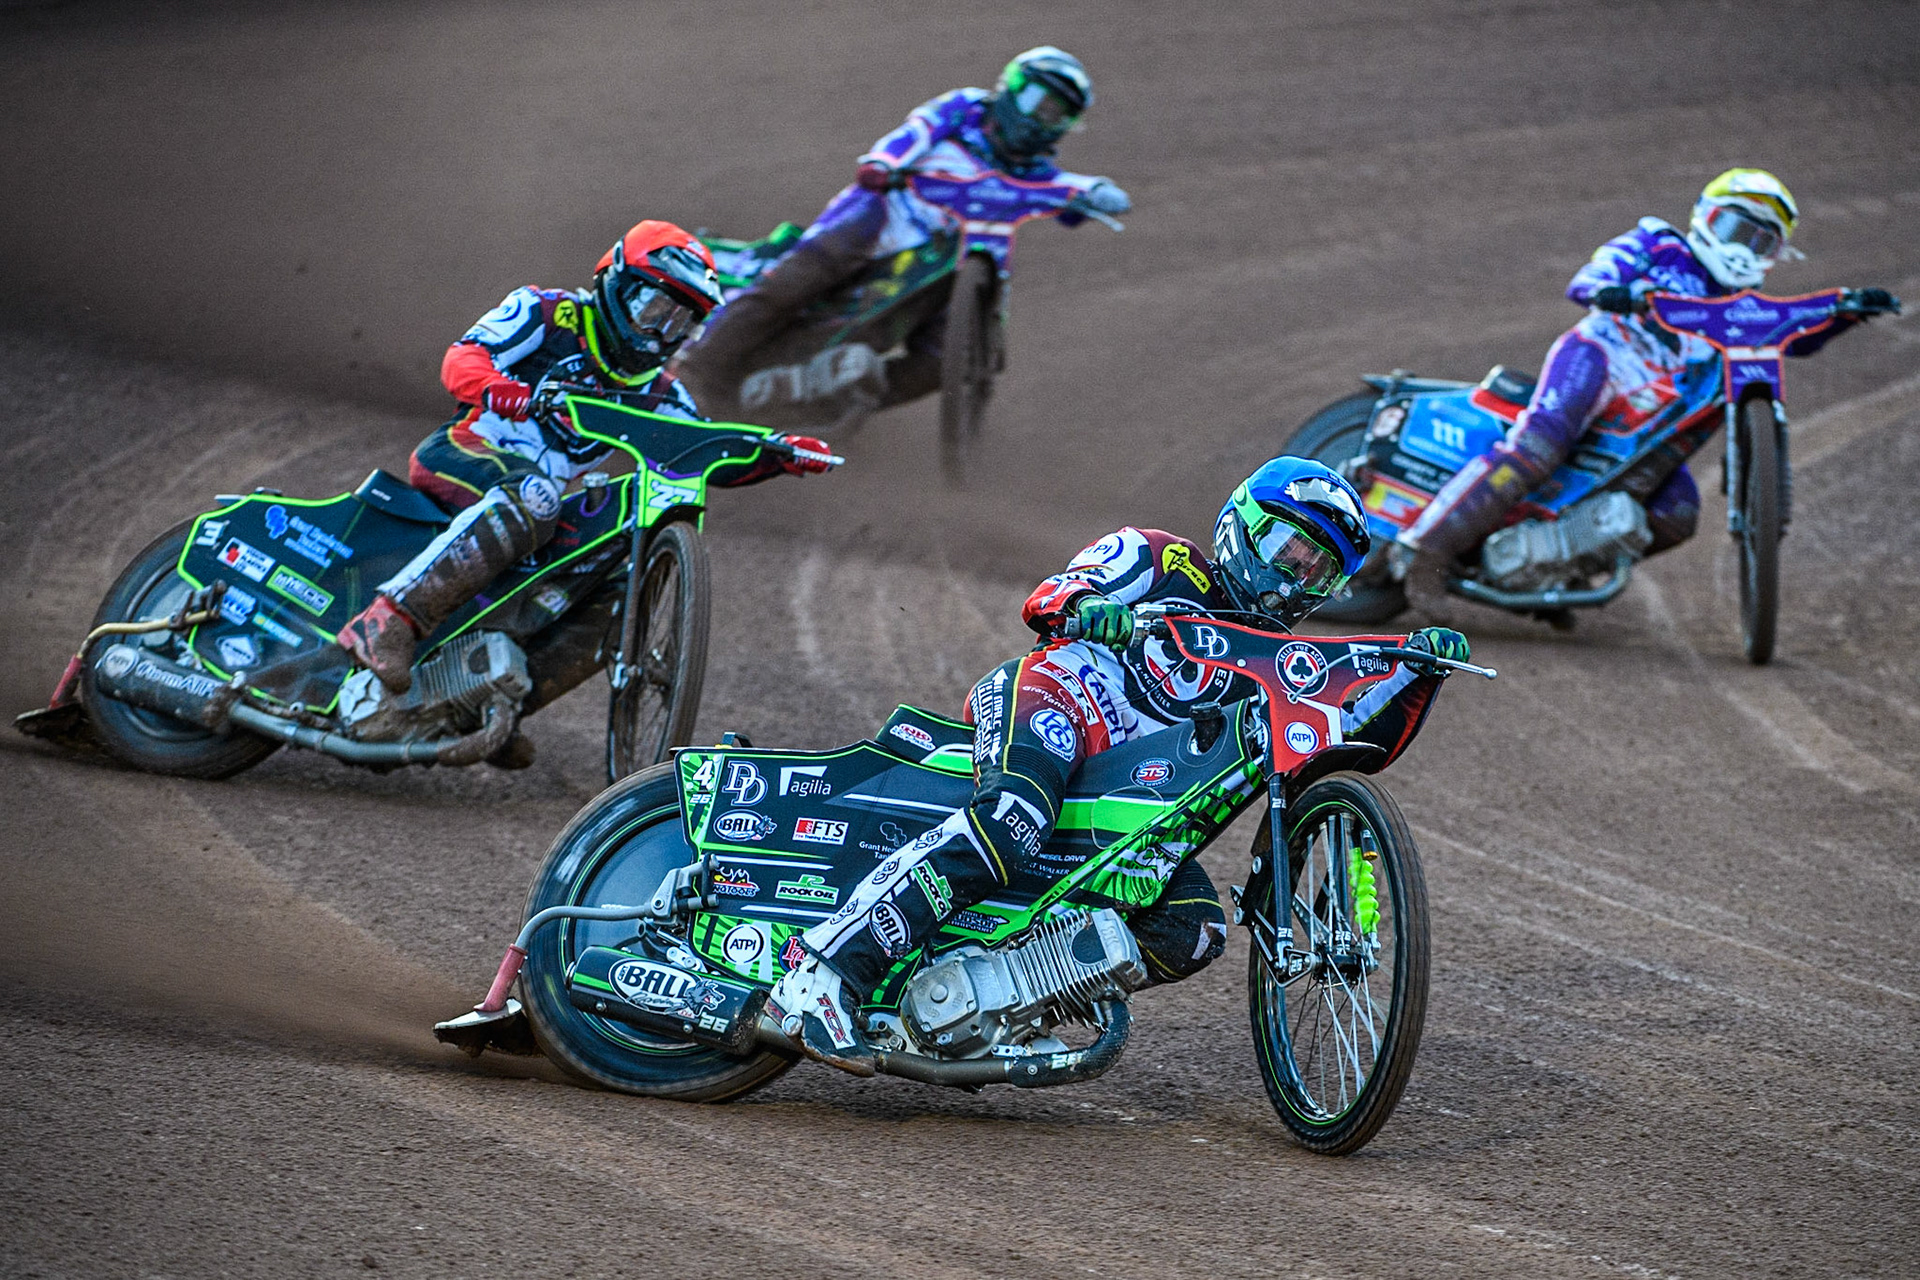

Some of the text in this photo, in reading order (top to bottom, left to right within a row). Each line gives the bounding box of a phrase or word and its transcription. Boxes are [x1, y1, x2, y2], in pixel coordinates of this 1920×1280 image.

[1360, 657, 1390, 672] agilia
[1061, 674, 1096, 722] FTS
[1290, 731, 1313, 744] ATPI
[692, 760, 713, 787] 4
[1138, 767, 1166, 777] STS
[790, 779, 832, 797] agilia
[690, 793, 712, 804] 26
[812, 821, 846, 838] FTS
[1005, 811, 1042, 857] agilia
[858, 841, 880, 851] Grant
[1063, 854, 1087, 863] DAVE
[917, 866, 940, 900] ROCK
[779, 886, 835, 900] ROCK OIL
[1277, 926, 1294, 939] 26
[729, 938, 757, 951] ATPI
[623, 965, 691, 998] BALL
[698, 1011, 730, 1034] 26
